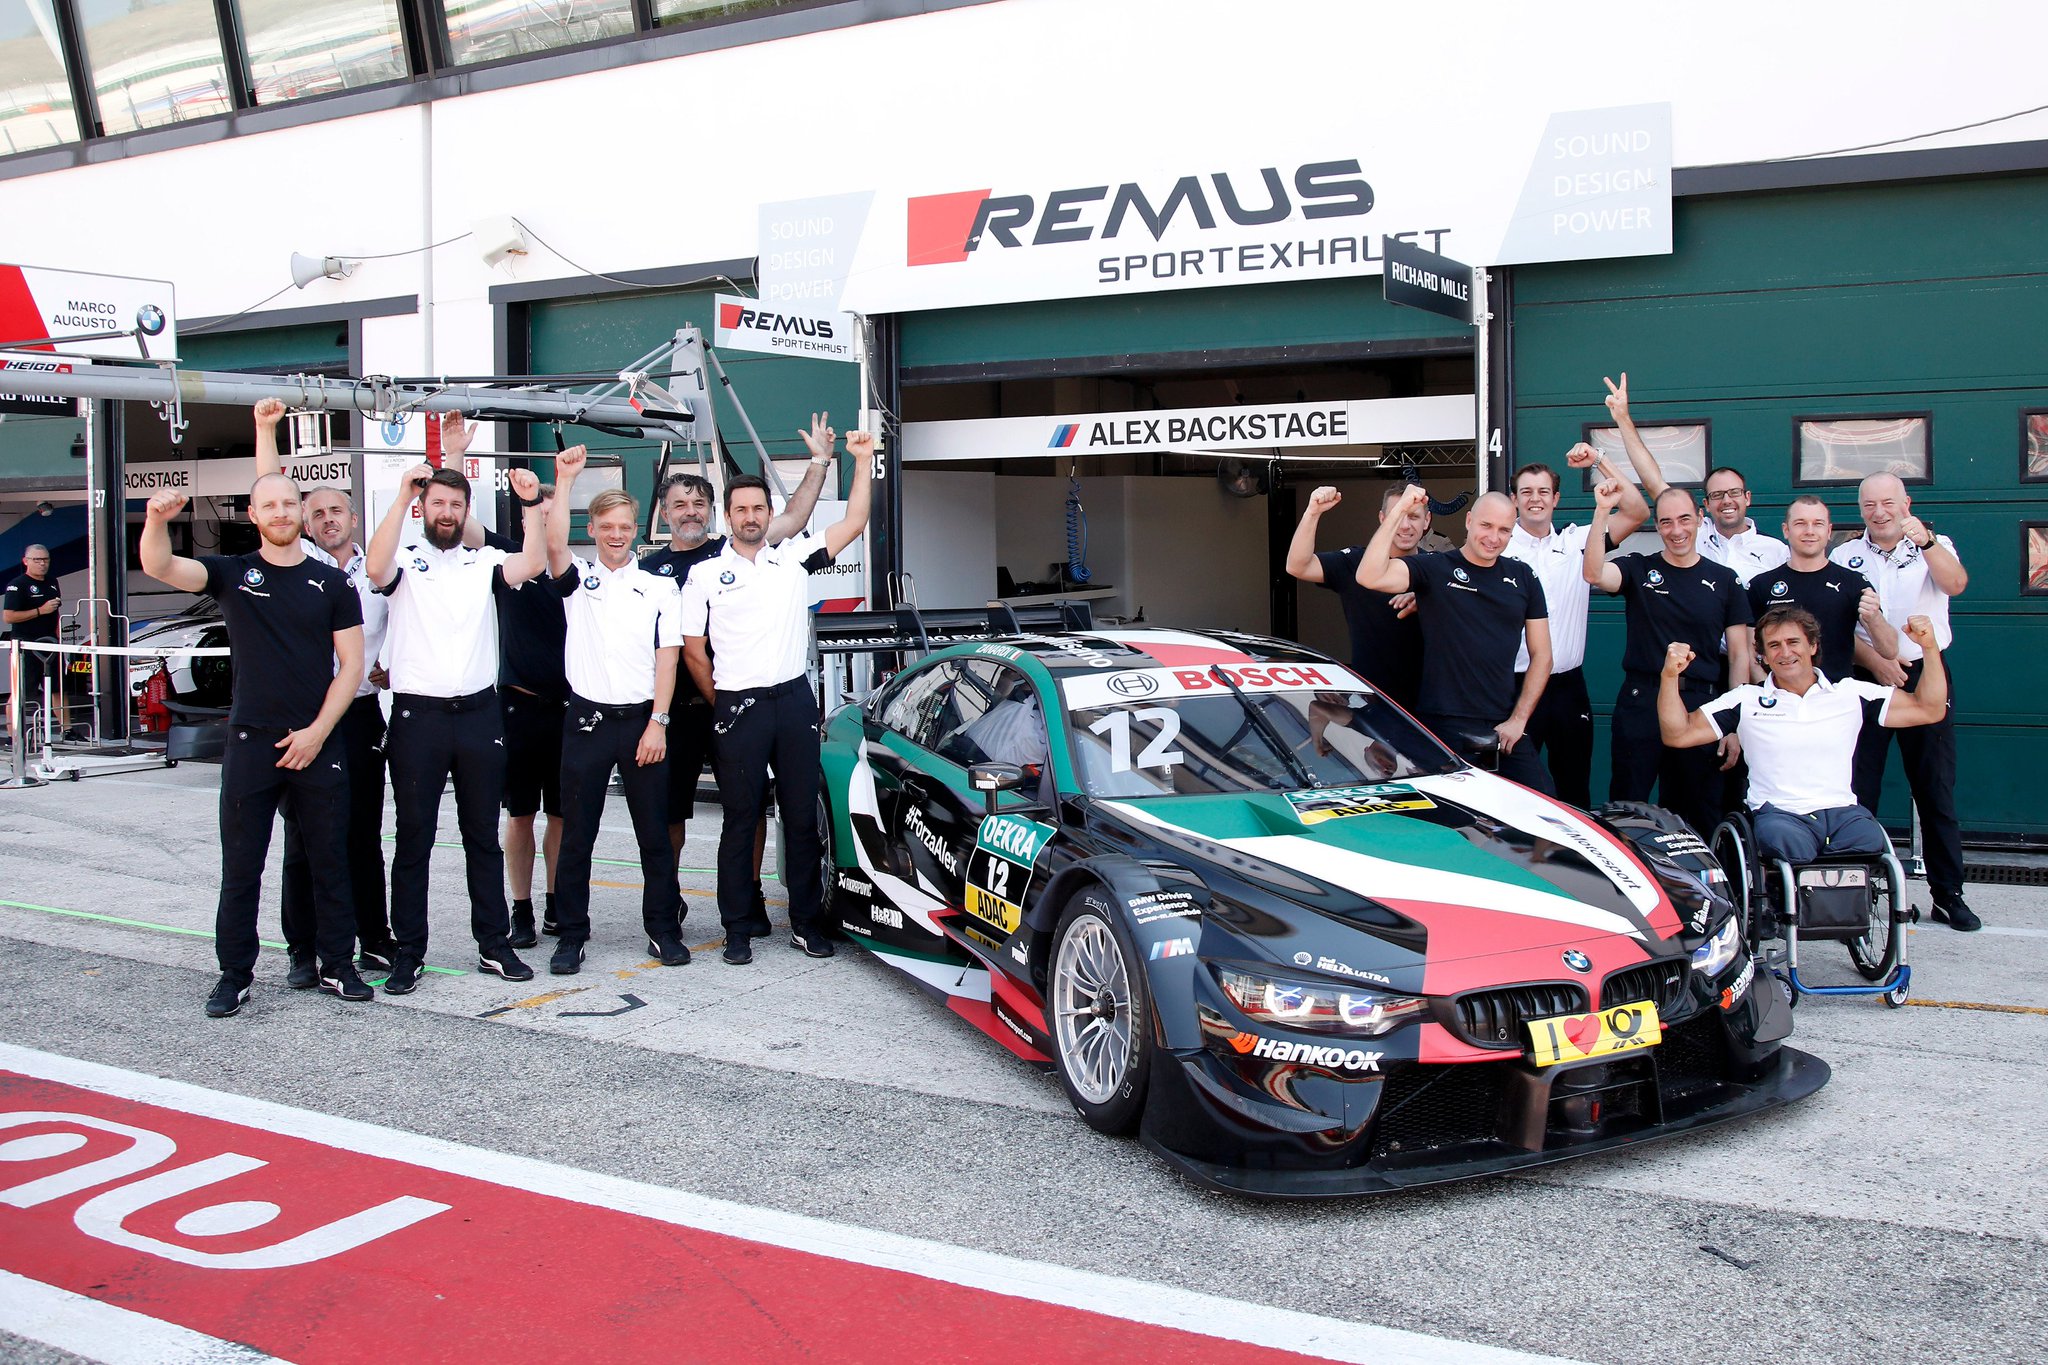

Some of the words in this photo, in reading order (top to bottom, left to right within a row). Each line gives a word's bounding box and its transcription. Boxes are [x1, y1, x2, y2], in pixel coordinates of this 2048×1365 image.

[1553, 130, 1651, 160] SOUND
[1554, 168, 1653, 198] DESIGN
[963, 159, 1374, 251] REMUS
[770, 216, 834, 241] SOUND
[1553, 207, 1652, 235] POWER
[770, 247, 834, 272] DESIGN
[1098, 228, 1451, 283] SPORTEXHAUST
[770, 279, 834, 302] POWER
[1392, 261, 1438, 292] RICHARD
[1440, 276, 1468, 301] MILLE
[68, 300, 117, 315] MARCO
[53, 314, 117, 330] AUGUSTO
[736, 309, 834, 339] REMUS
[771, 337, 848, 354] SPORTEXHAUST
[5, 361, 57, 373] HEIGO
[1089, 419, 1161, 446] ALEX
[1168, 410, 1348, 443] BACKSTAGE
[495, 468, 509, 491] 36
[95, 489, 105, 508] 37
[867, 635, 950, 645] DRNG
[1172, 666, 1334, 691] BOSCH
[1087, 706, 1185, 774] 12
[975, 780, 996, 789] PUMA
[1291, 785, 1409, 800] DEKRA
[1332, 803, 1410, 817] ADAC
[905, 805, 957, 877] #ForzaAlex
[983, 815, 1037, 861] DEKRA
[1566, 833, 1642, 889] Motorsport
[986, 856, 1010, 898] 12
[977, 891, 1008, 930] ADAC
[1128, 894, 1156, 907] BMW
[1156, 892, 1193, 902] Driving
[1132, 901, 1189, 916] Experience
[1354, 970, 1391, 984] ULTRA
